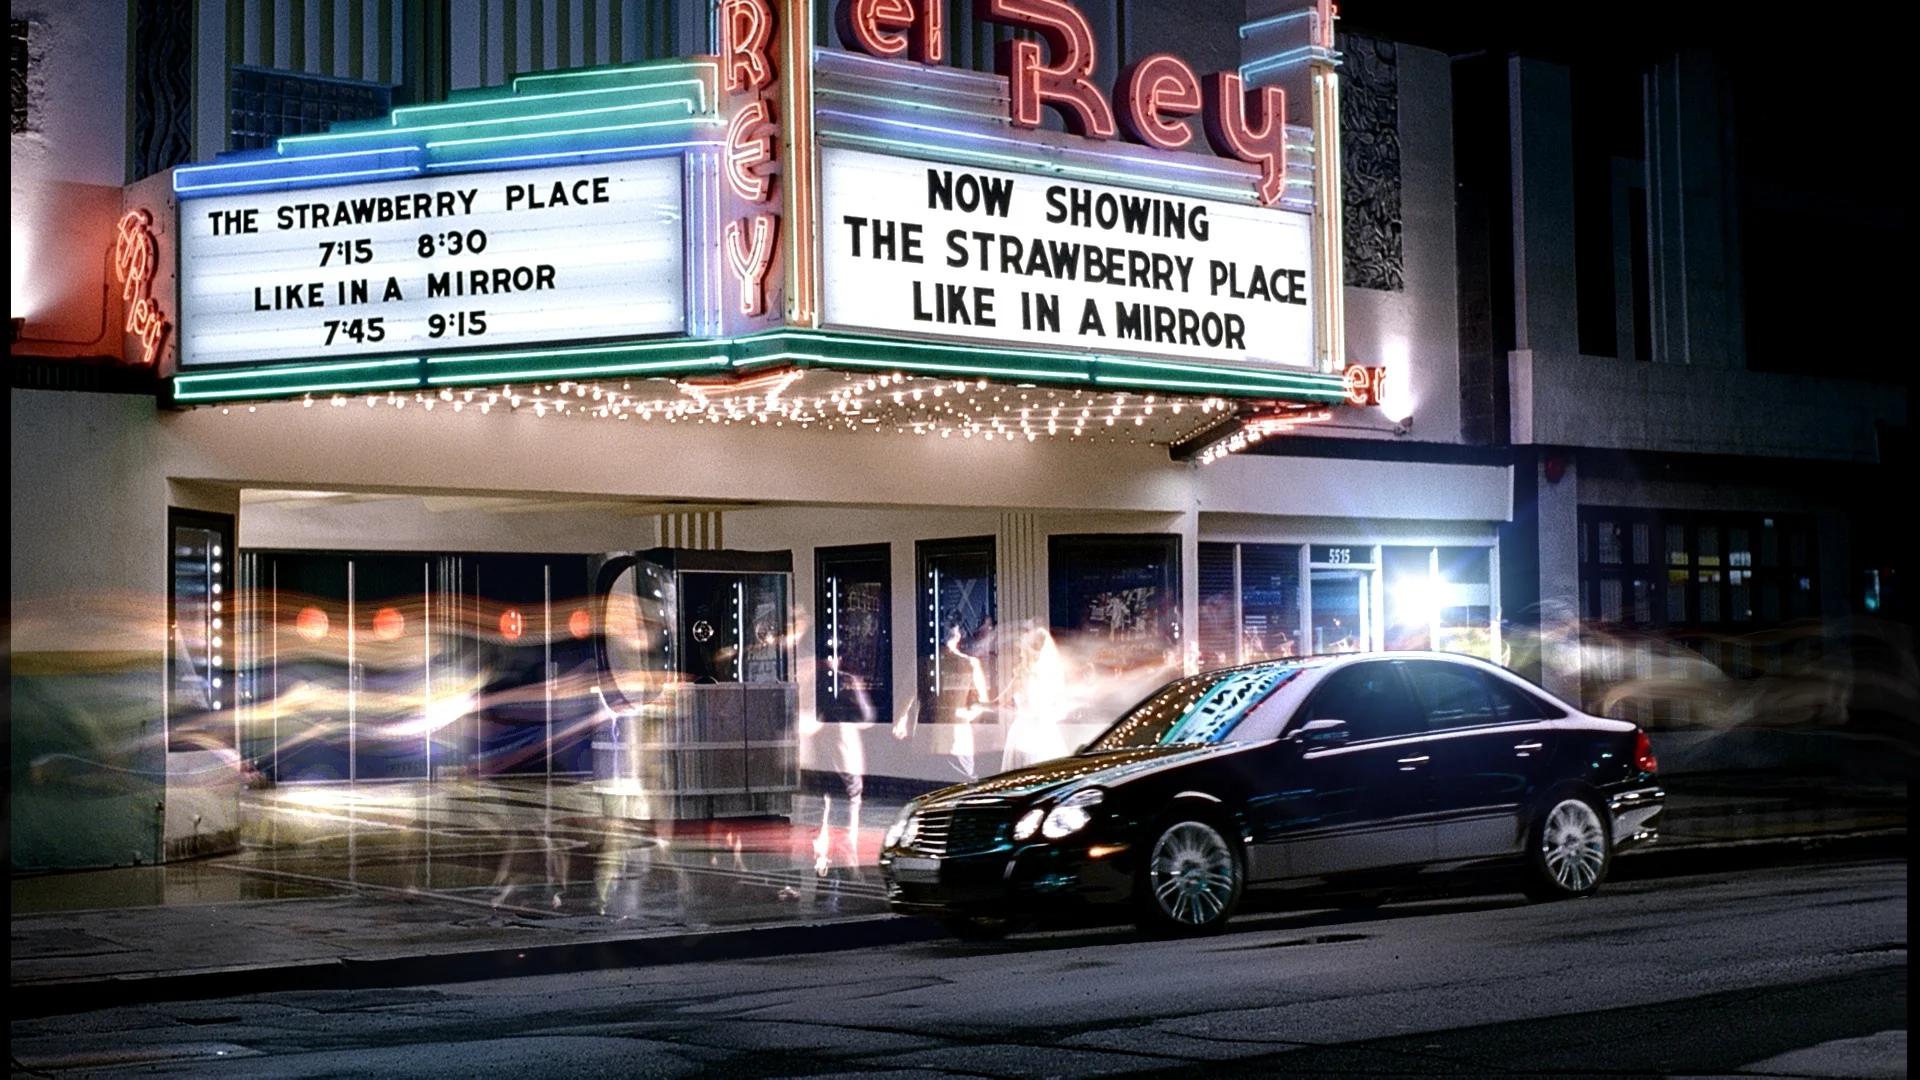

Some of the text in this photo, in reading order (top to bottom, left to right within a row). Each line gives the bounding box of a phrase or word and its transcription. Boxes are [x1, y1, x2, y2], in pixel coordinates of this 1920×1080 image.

[978, 0, 1287, 205] Rey
[723, 0, 775, 318] REY
[208, 176, 610, 236] THE STRAWBERRY PLACE
[927, 168, 1209, 242] NOW SHOWING
[319, 229, 487, 267] 7:15 8:30
[843, 215, 1305, 306] THE STRAWBERRY PLACE
[254, 264, 556, 312] LIKE IN A MIRROR
[912, 280, 1246, 350] LIKE IN A MIRROR
[323, 310, 487, 346] 7:45 9:15
[1329, 548, 1350, 564] 5515
